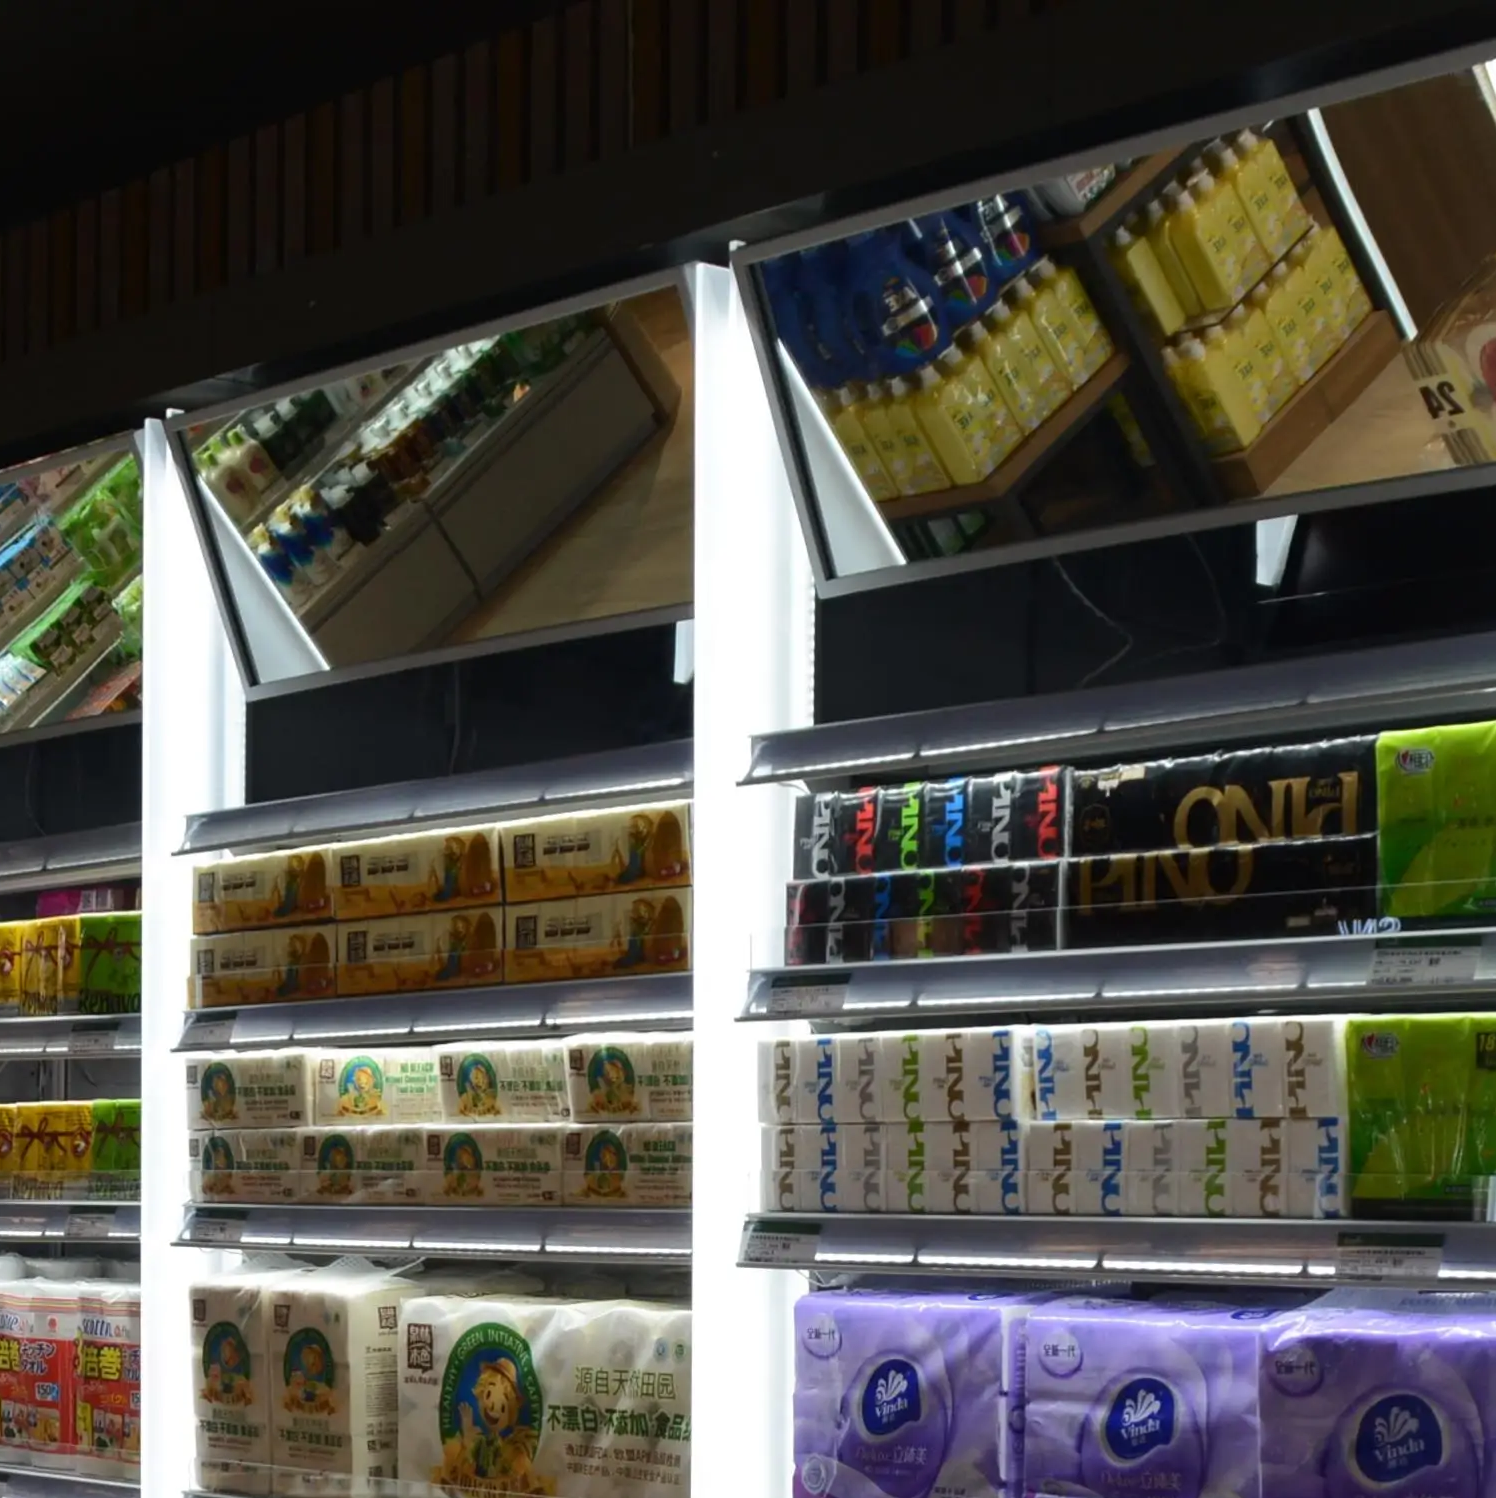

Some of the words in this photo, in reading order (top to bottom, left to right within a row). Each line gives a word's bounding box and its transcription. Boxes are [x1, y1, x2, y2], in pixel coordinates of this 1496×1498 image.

[21, 1341, 56, 1357] キッチン
[457, 1332, 484, 1362] GREEN
[874, 1397, 908, 1418] Vinda
[1121, 1418, 1161, 1441] Vinda
[1374, 1440, 1425, 1462] Vinda
